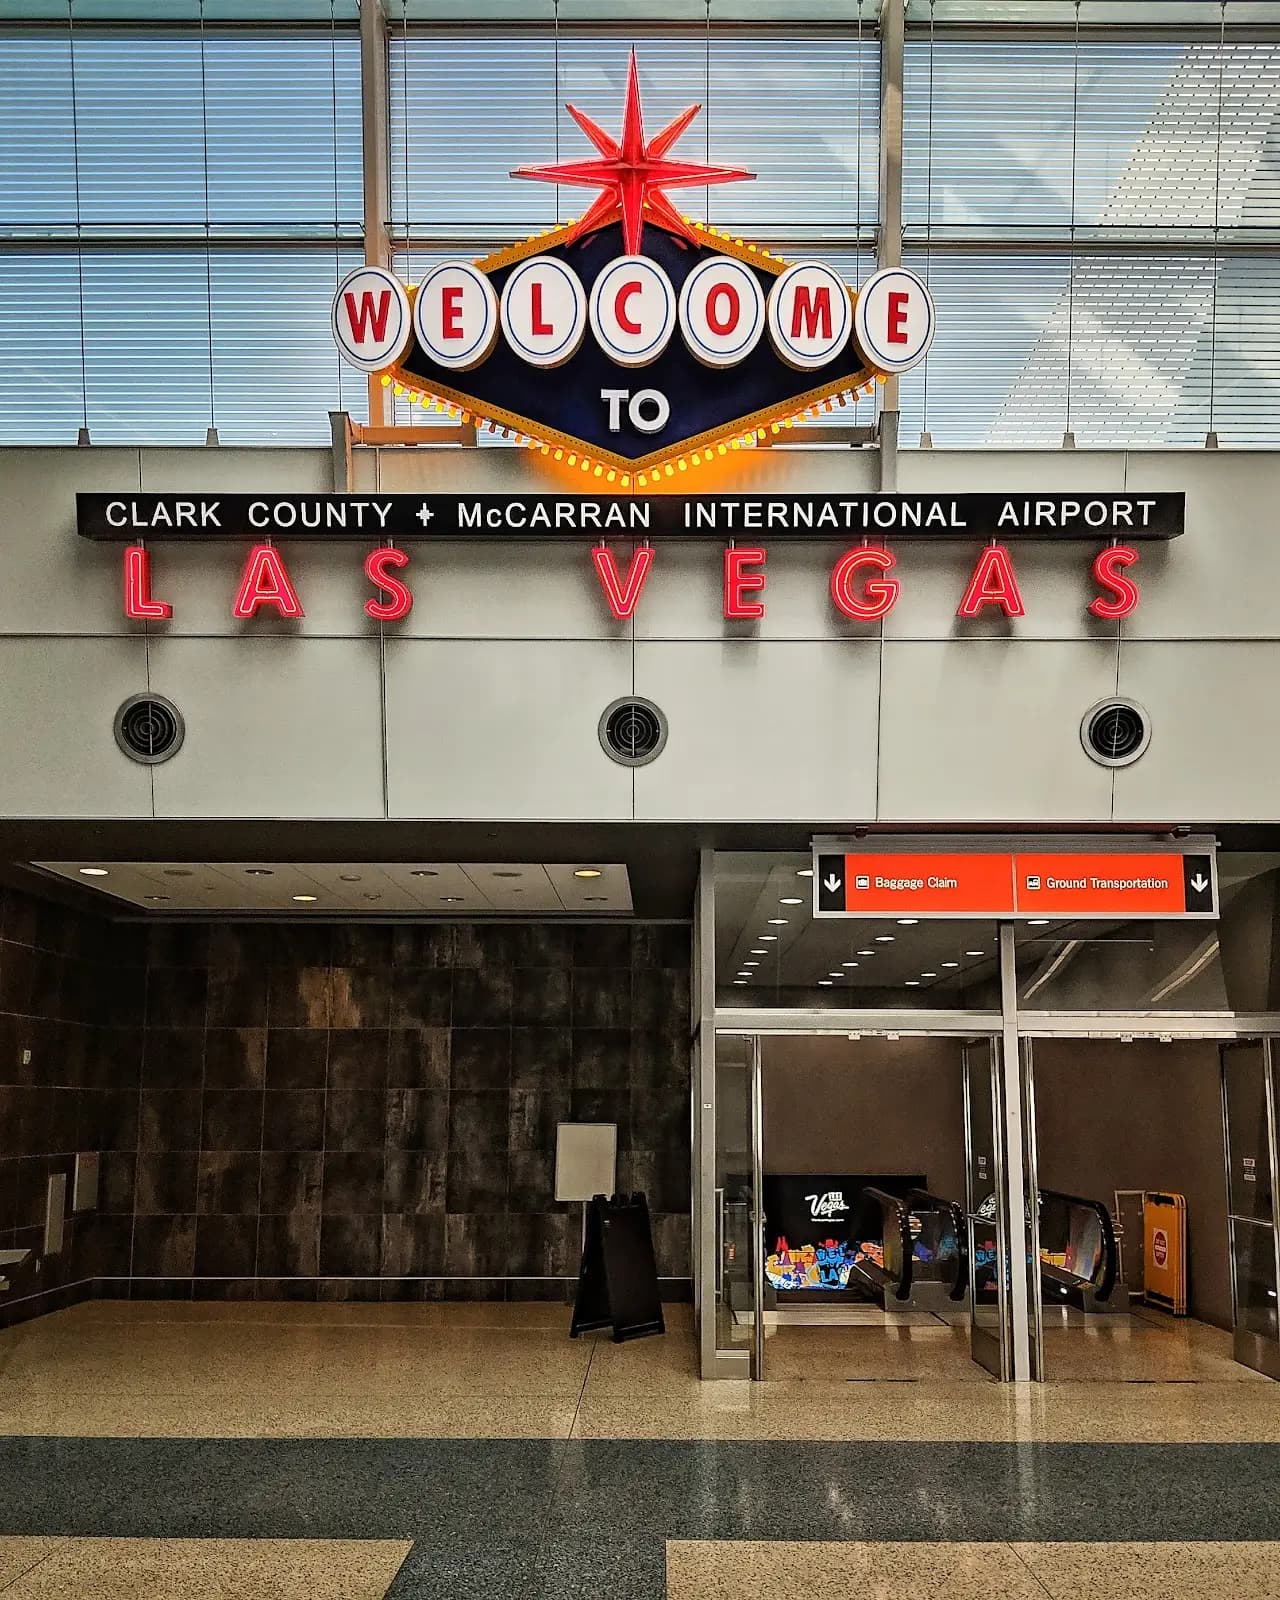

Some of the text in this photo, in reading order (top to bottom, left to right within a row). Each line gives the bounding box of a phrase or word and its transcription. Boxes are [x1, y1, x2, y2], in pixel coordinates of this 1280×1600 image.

[344, 281, 909, 345] WELCOME
[600, 388, 671, 434] TO
[105, 500, 1157, 529] CLARK COUNTY McCARRAN INTERNATIONAL AIRPORT
[124, 544, 1140, 622] LAS VEGAS
[875, 876, 958, 890] Baggage Claim
[1046, 876, 1169, 891] Ground Transportation
[804, 1193, 850, 1217] Vegas
